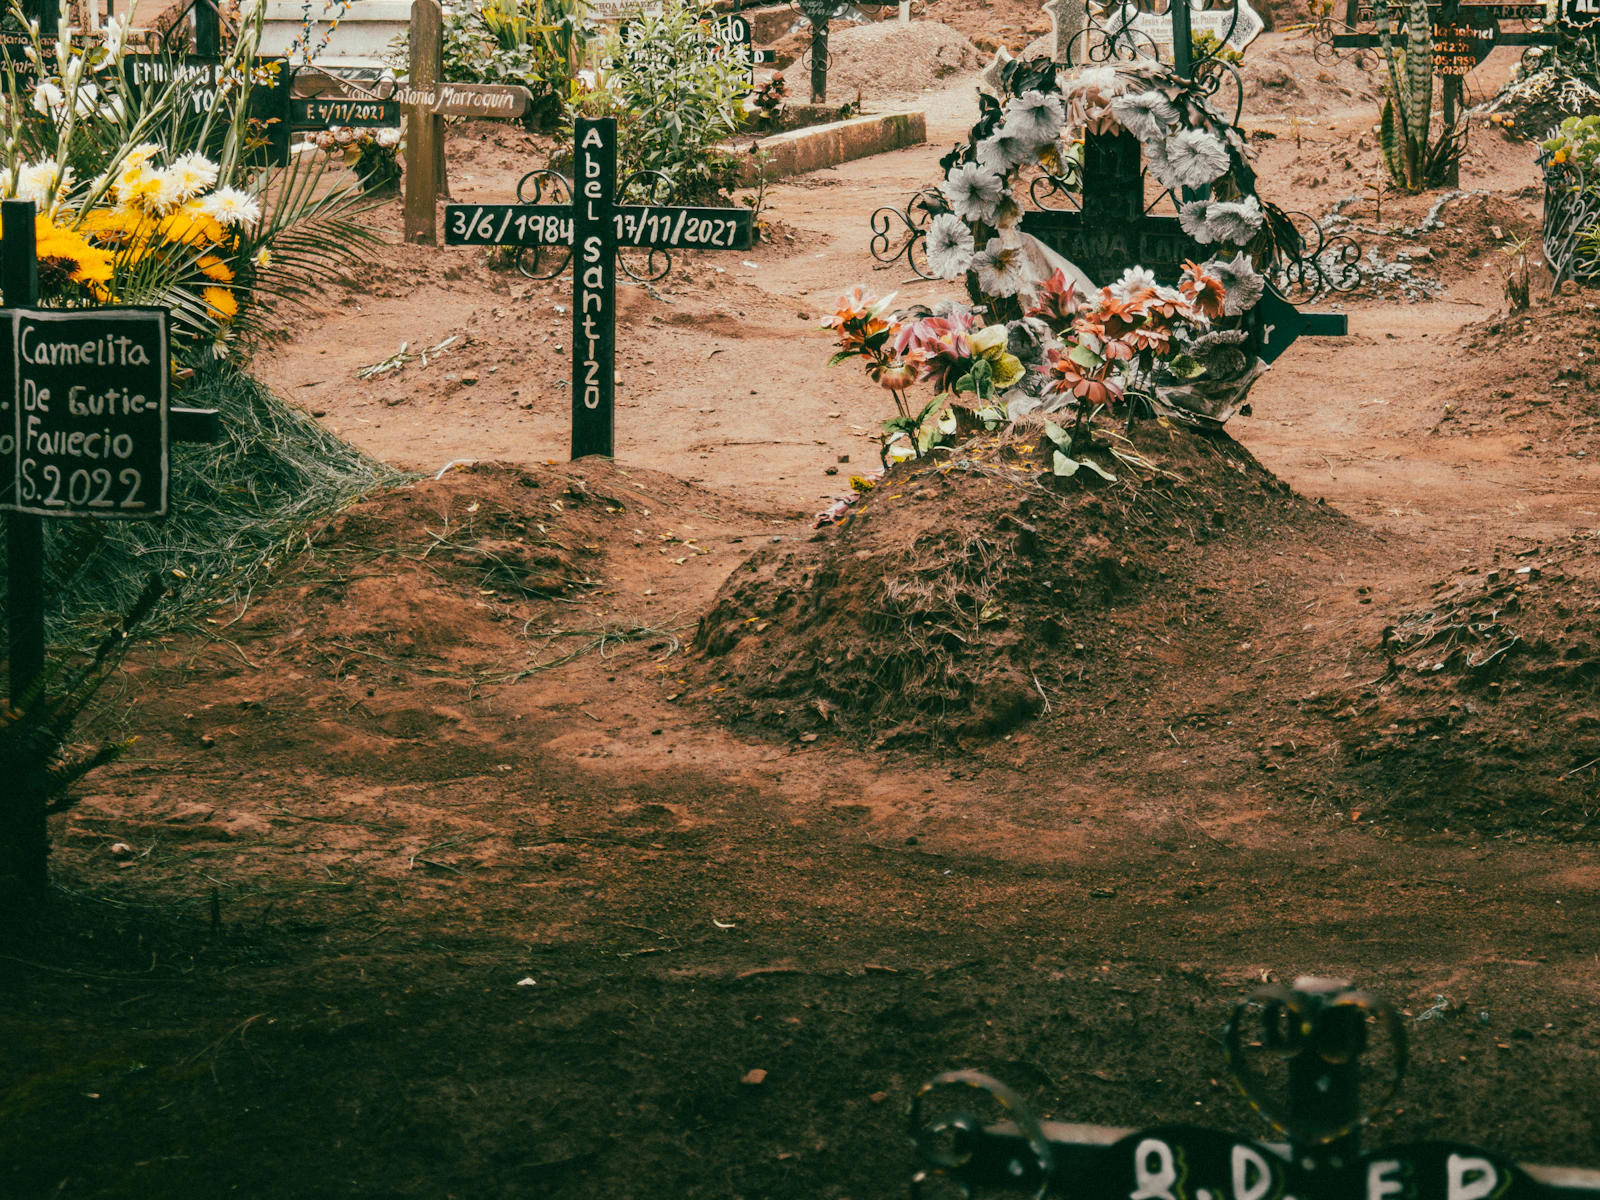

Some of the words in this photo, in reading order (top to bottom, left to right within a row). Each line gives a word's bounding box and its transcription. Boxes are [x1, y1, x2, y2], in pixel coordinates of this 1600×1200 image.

[451, 207, 574, 246] 3/6/1984
[612, 207, 737, 247] 17/11/2021
[21, 325, 151, 366] Carmelita
[23, 378, 51, 412] De
[26, 414, 134, 459] Fallecio
